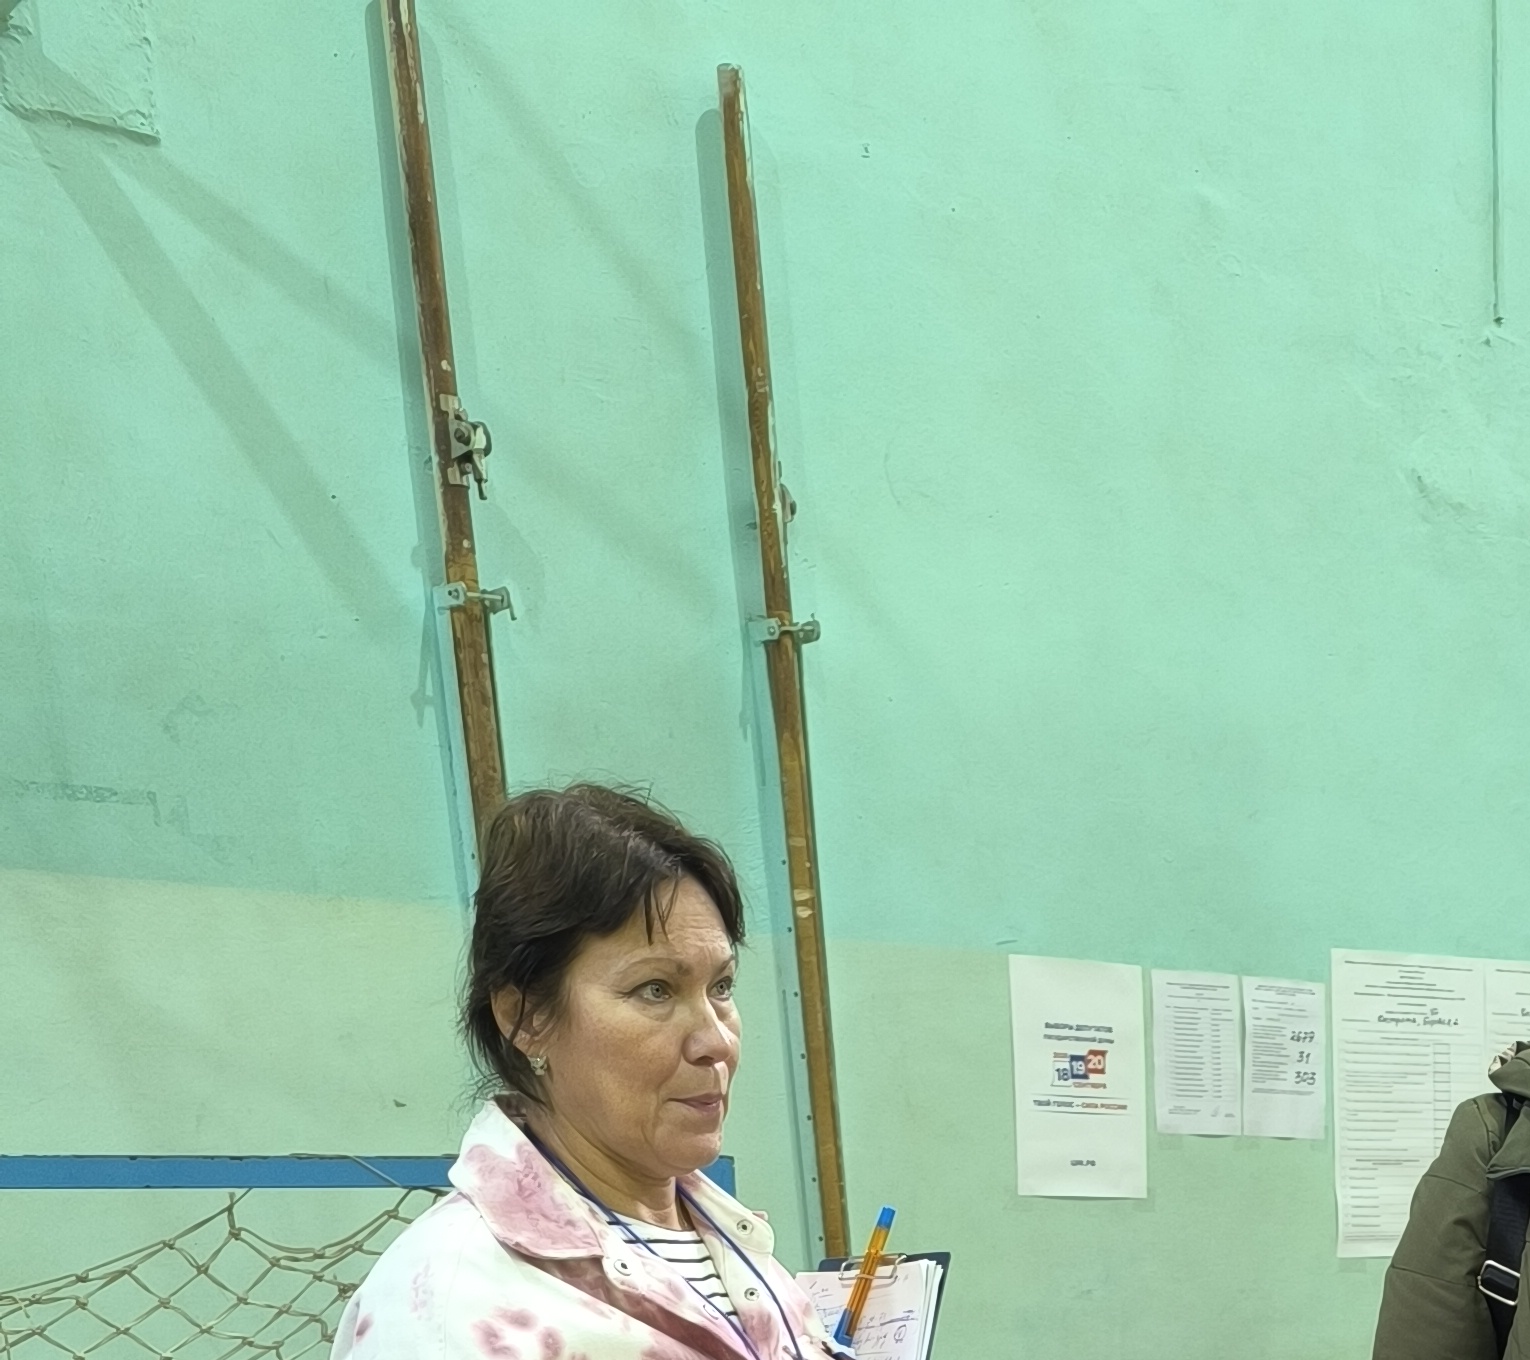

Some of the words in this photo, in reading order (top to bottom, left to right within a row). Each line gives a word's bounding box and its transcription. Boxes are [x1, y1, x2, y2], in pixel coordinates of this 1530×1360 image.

[1055, 1067, 1070, 1081] 18
[1071, 1061, 1085, 1075] 19
[1087, 1054, 1104, 1069] 20
